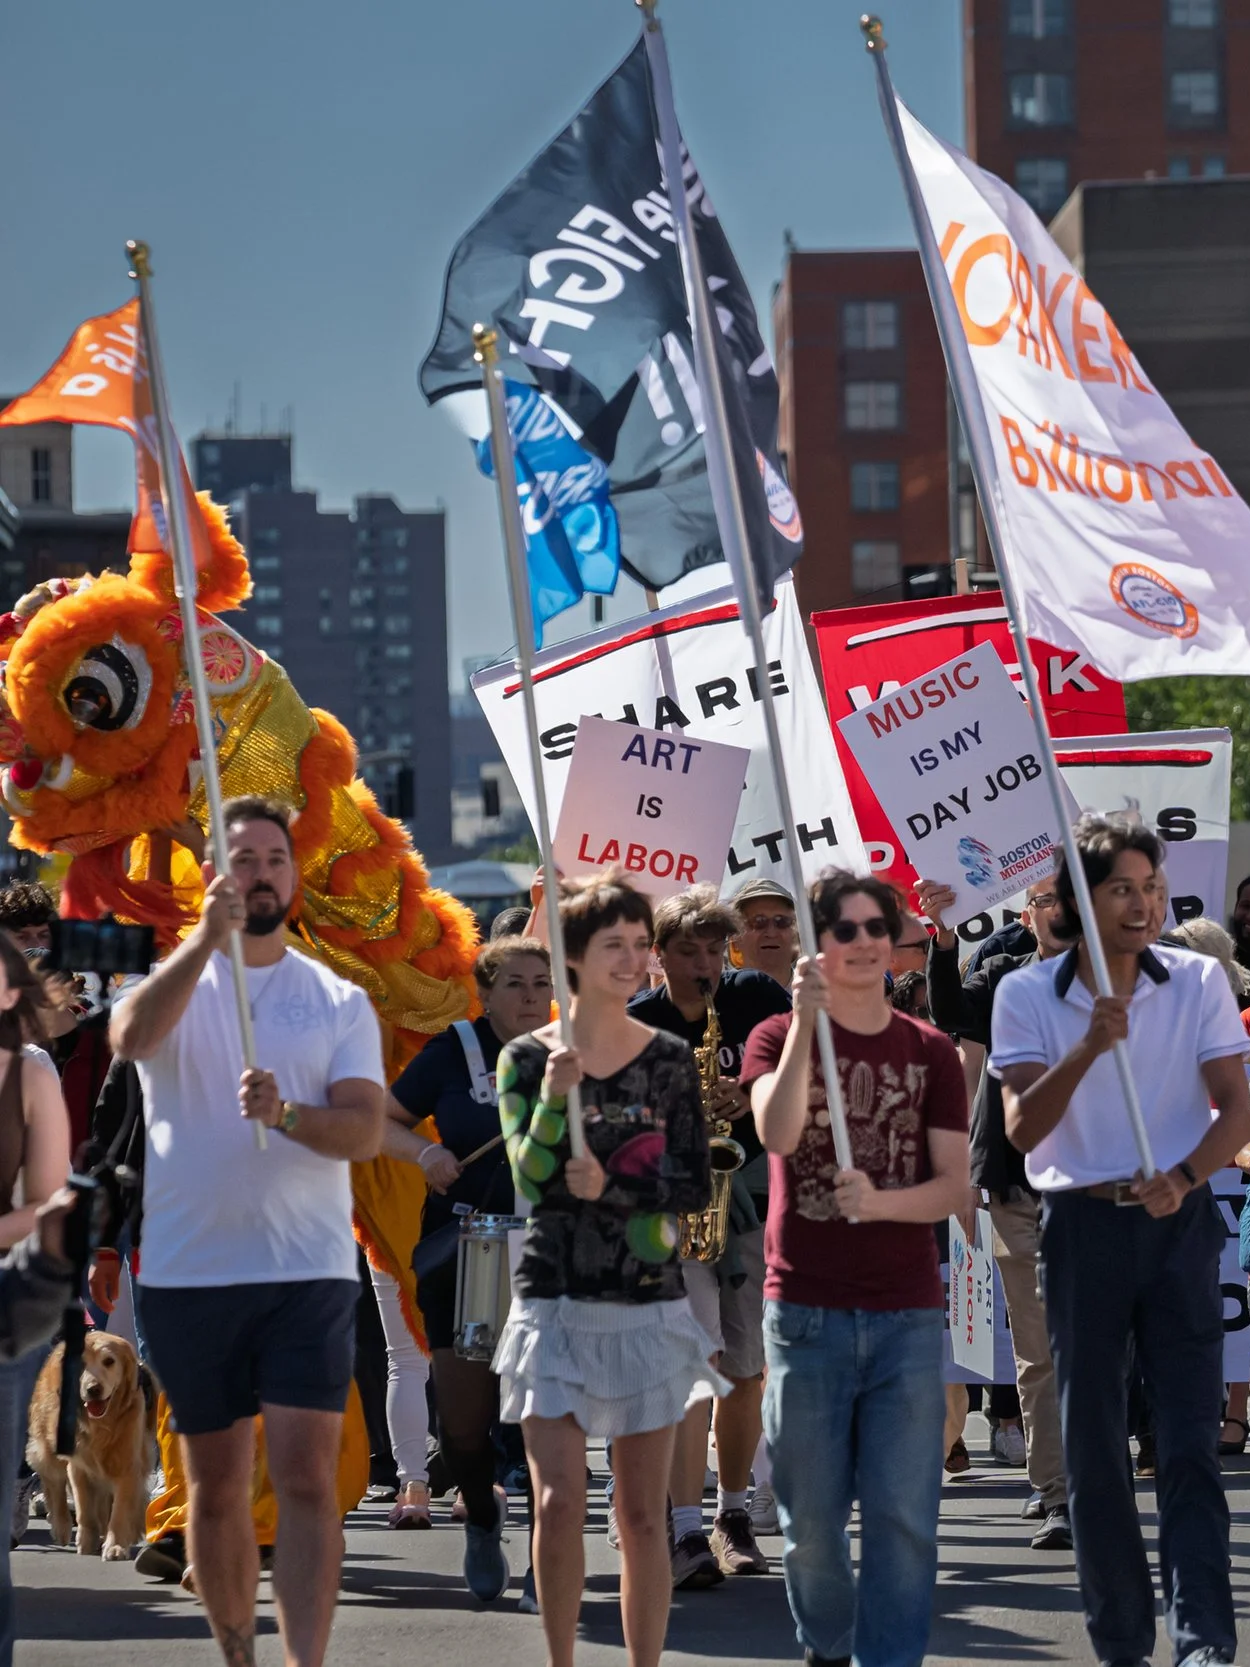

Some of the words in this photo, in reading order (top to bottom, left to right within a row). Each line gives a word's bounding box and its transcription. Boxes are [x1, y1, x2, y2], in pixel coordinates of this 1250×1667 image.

[939, 221, 1155, 395] ORKER
[865, 661, 980, 739] MUSIC
[621, 733, 701, 774] ART
[910, 748, 940, 776] IS
[940, 721, 984, 760] MY
[636, 794, 664, 819] IS
[906, 787, 972, 841] DAY
[983, 753, 1043, 802] JOB
[577, 833, 699, 884] LABOR
[998, 832, 1051, 868] BOSTON
[1000, 844, 1056, 880] MUSICIANS
[1036, 863, 1056, 876] MUS
[966, 1250, 974, 1344] ABOR
